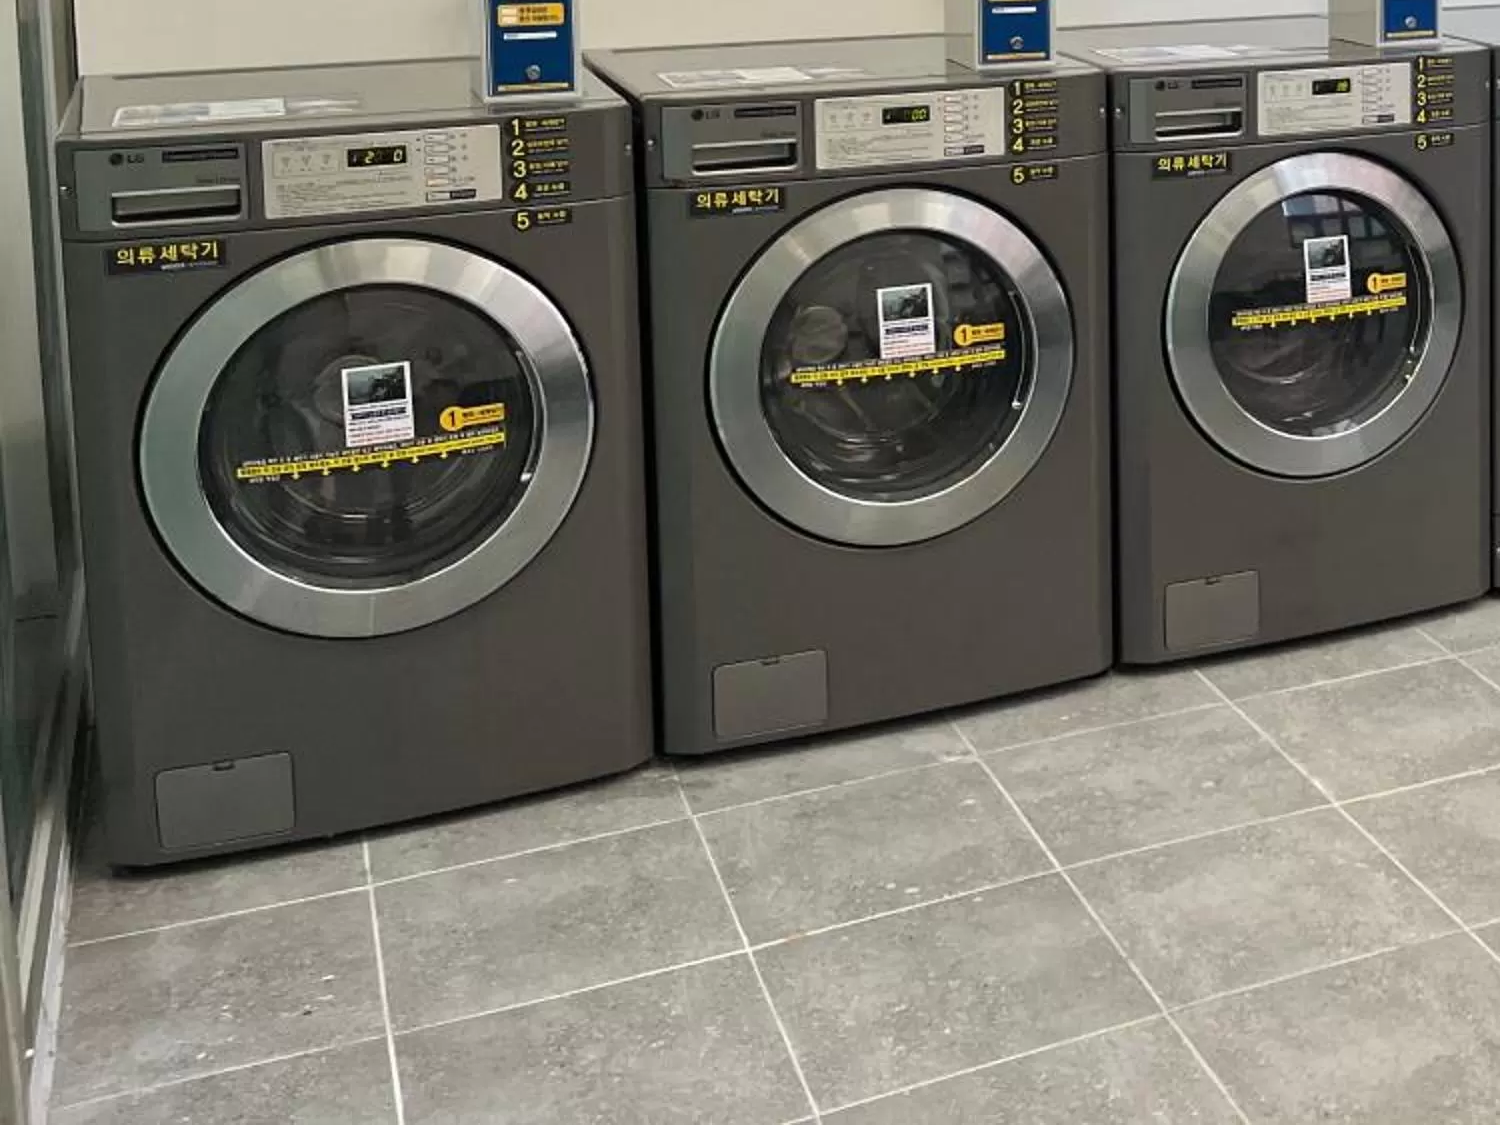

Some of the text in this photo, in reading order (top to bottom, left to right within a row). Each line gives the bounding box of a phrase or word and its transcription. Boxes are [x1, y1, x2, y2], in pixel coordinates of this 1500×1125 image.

[1417, 75, 1426, 88] 2
[1013, 99, 1024, 114] 2
[1417, 92, 1426, 106] 3
[1417, 109, 1426, 123] 4
[1013, 118, 1023, 133] 3
[512, 139, 524, 156] 2
[1013, 137, 1024, 151] 4
[514, 160, 526, 177] 3
[1013, 167, 1025, 183] 5
[514, 183, 528, 199] 4
[517, 212, 530, 229] 5
